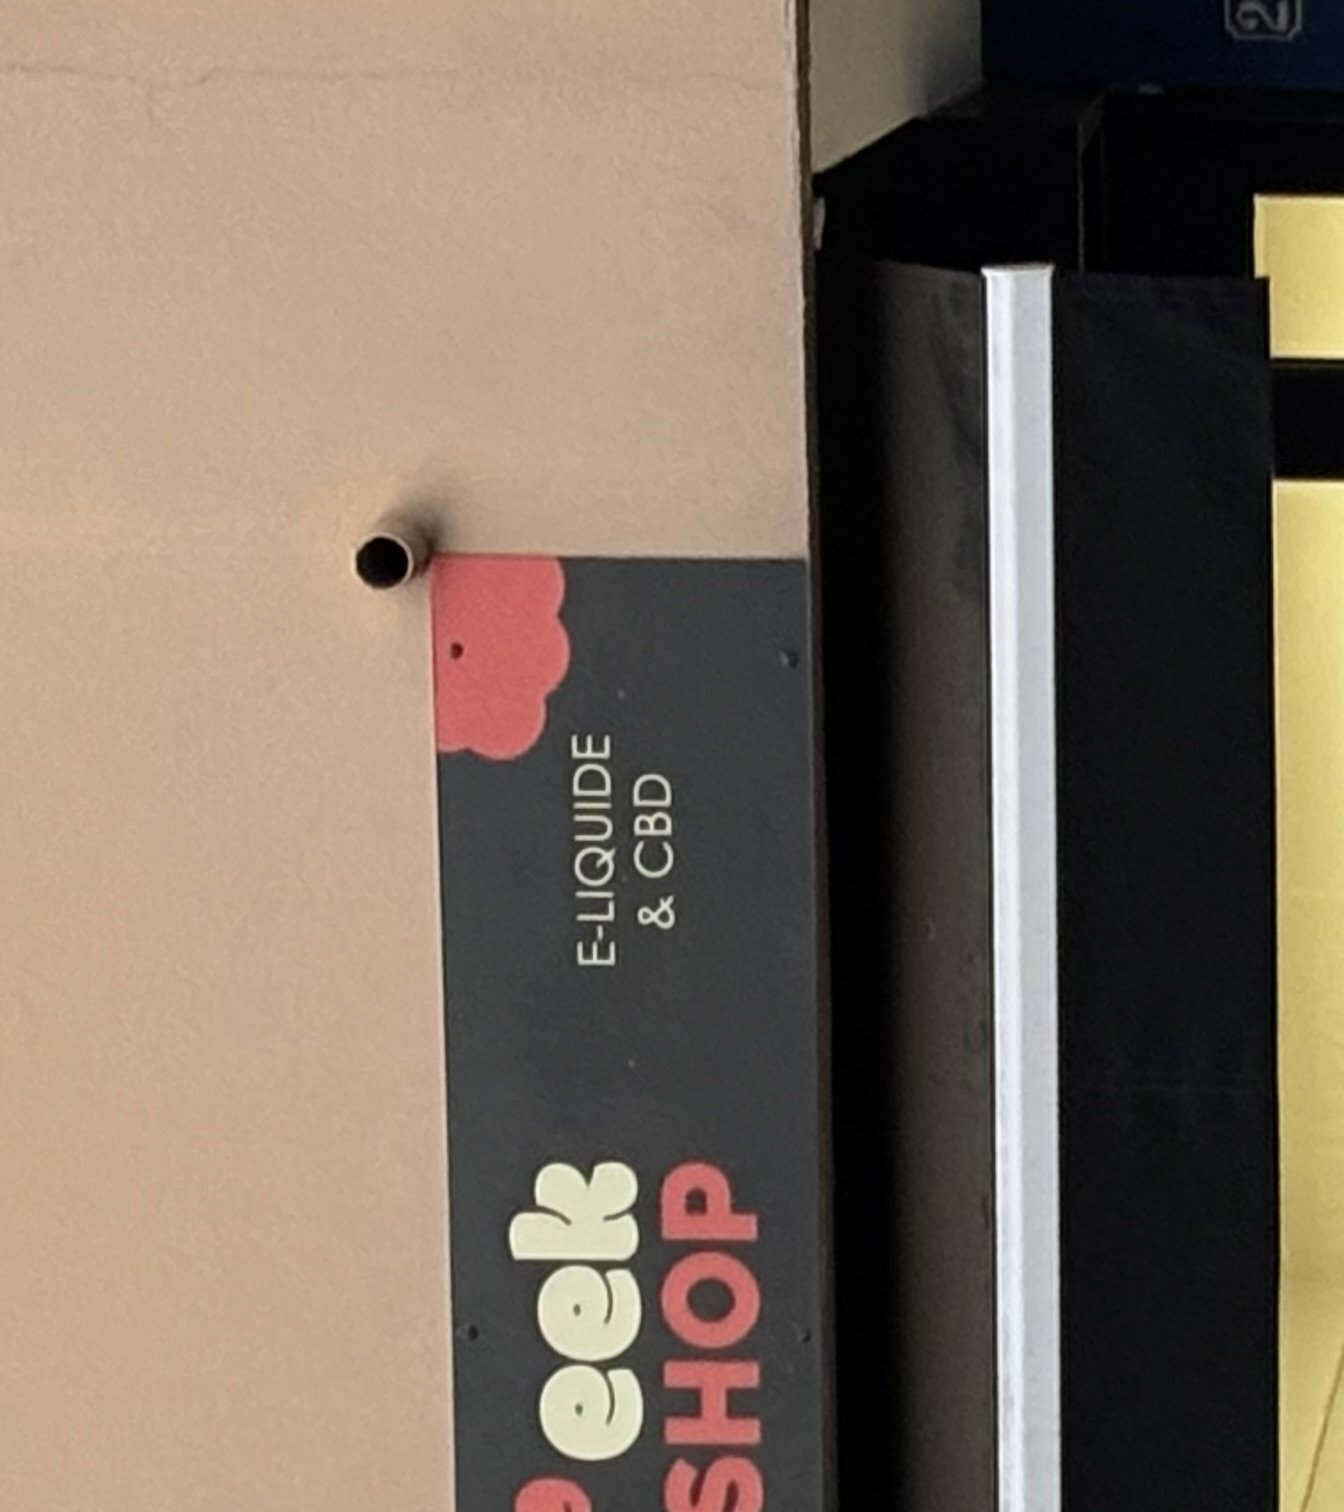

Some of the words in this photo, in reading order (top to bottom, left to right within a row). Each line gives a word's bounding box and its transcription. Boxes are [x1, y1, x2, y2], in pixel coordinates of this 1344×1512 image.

[571, 733, 617, 967] E-LIQUIDE
[632, 772, 675, 879] CBD
[637, 895, 676, 931] &
